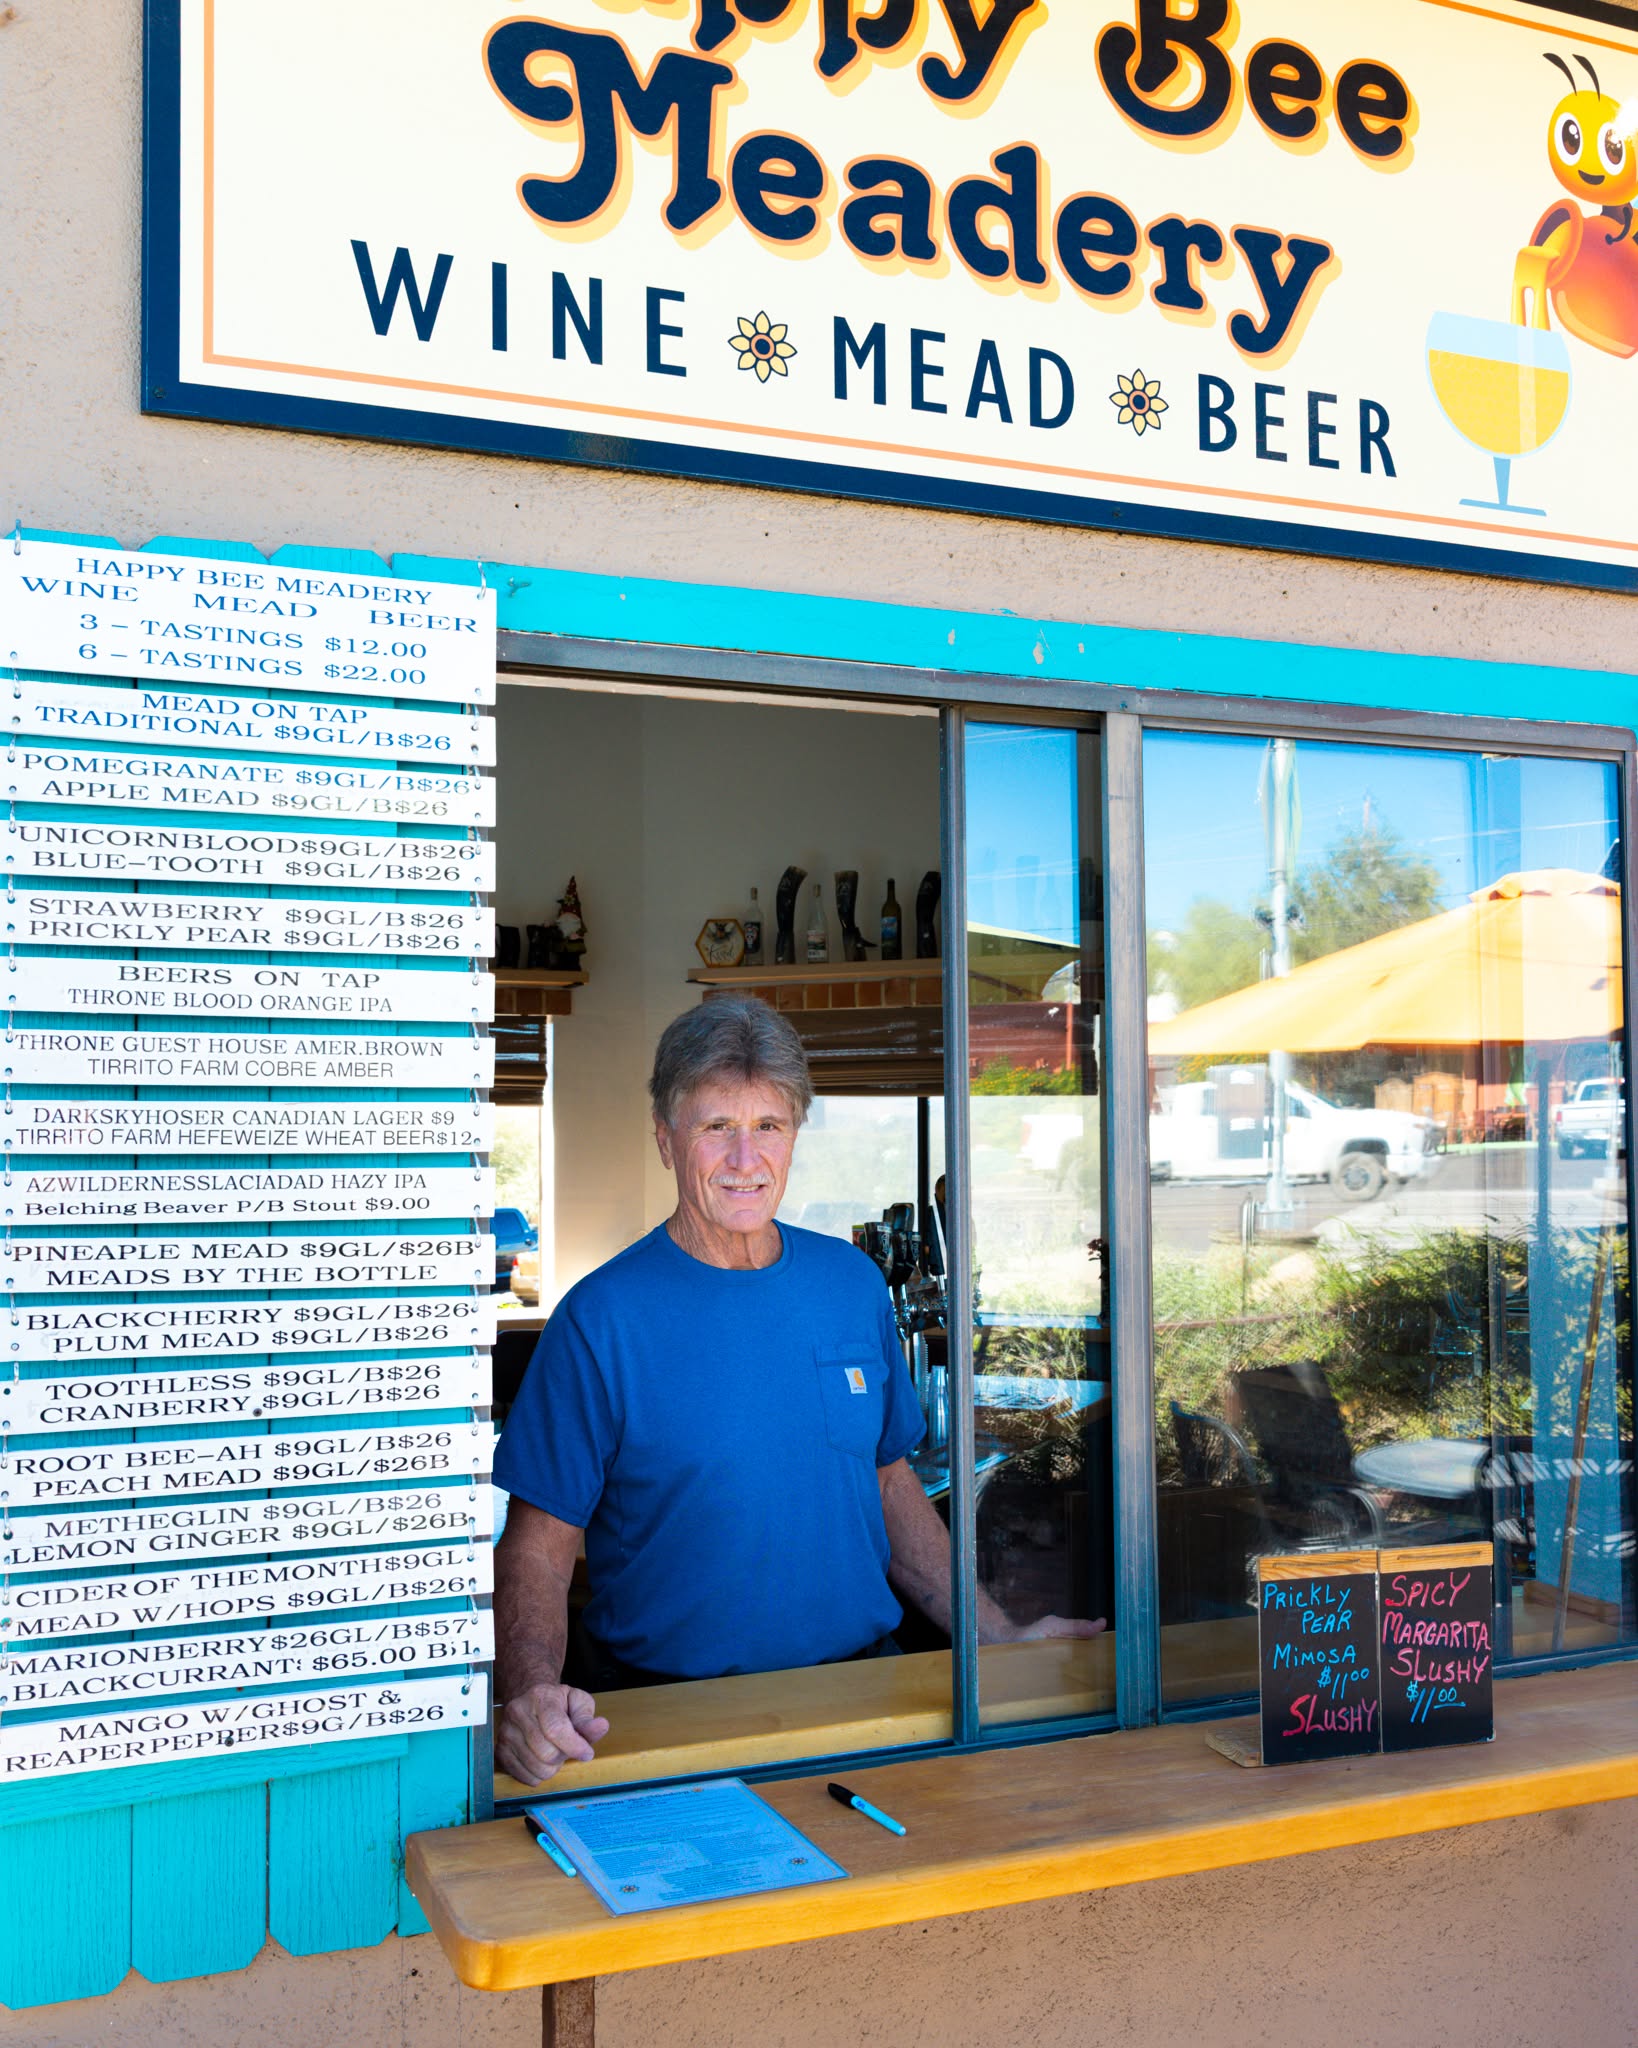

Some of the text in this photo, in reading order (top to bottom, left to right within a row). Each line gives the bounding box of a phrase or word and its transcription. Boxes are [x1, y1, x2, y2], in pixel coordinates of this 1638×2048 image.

[483, 15, 1336, 356] Meadery
[350, 239, 1398, 478] WINE MEAD BEER
[76, 557, 432, 606] HAPPY BEE MEADERY
[19, 575, 477, 633] WINE MEAD BEER
[140, 619, 304, 649] TASTINGS
[139, 648, 303, 676] TASTINGS
[34, 705, 263, 738] TRADITIONAL
[141, 693, 368, 725] MEAD ON TAP
[23, 753, 284, 784] POMEGRANATE
[41, 779, 150, 801] APPLE
[161, 786, 260, 807] MEAD
[28, 897, 264, 922] STRAWBERRY
[28, 919, 175, 941] PRICKLY
[185, 926, 272, 945] PEAR
[117, 965, 381, 989] BEERS ON TAP
[67, 988, 393, 1013] THRONE BLOOD ORANGE IPA
[14, 1034, 115, 1052] THRONE
[122, 1035, 201, 1054] GUEST
[208, 1038, 288, 1055] HOUSE
[87, 1058, 394, 1078] TIRRITO FARM COBRE AMBER
[232, 1109, 346, 1126] CANADIAN
[353, 1110, 424, 1126] LAGER
[15, 1127, 104, 1146] TIRRITO
[111, 1128, 172, 1145] FARM
[178, 1128, 299, 1146] HEFEWEIZE
[305, 1129, 377, 1146] WHEAT
[331, 1173, 388, 1190] HAZY
[393, 1173, 427, 1189] IPA
[24, 1201, 138, 1217] Belching
[143, 1201, 229, 1215] Beaver
[236, 1199, 285, 1213] P/B
[292, 1199, 357, 1213] Stout
[11, 1243, 181, 1263] PINEAPLE
[191, 1242, 289, 1260] MEAD
[45, 1268, 171, 1287] MEADS
[182, 1268, 227, 1285] BY
[314, 1265, 438, 1282] BOTTLE
[25, 1307, 283, 1331] BLACKCHERRY
[52, 1334, 150, 1354] PLUM
[160, 1331, 260, 1350] MEAD
[44, 1373, 252, 1401] TOOTHLESS
[39, 1395, 252, 1424] CRANBERRY
[13, 1453, 114, 1476] ROOT
[32, 1474, 152, 1498] PEACH
[162, 1467, 262, 1490] MEAD
[44, 1506, 251, 1539] METHEGLIN
[10, 1537, 138, 1566] LEMON
[148, 1526, 281, 1552] GINGER
[1384, 1571, 1471, 1608] SPICY
[15, 1611, 120, 1637] MEAD
[131, 1594, 276, 1624] W/HOPS
[1302, 1609, 1352, 1634] PEAR
[1382, 1610, 1492, 1652] MARGARITA
[57, 1689, 402, 1743] MANGO W/GHOST &
